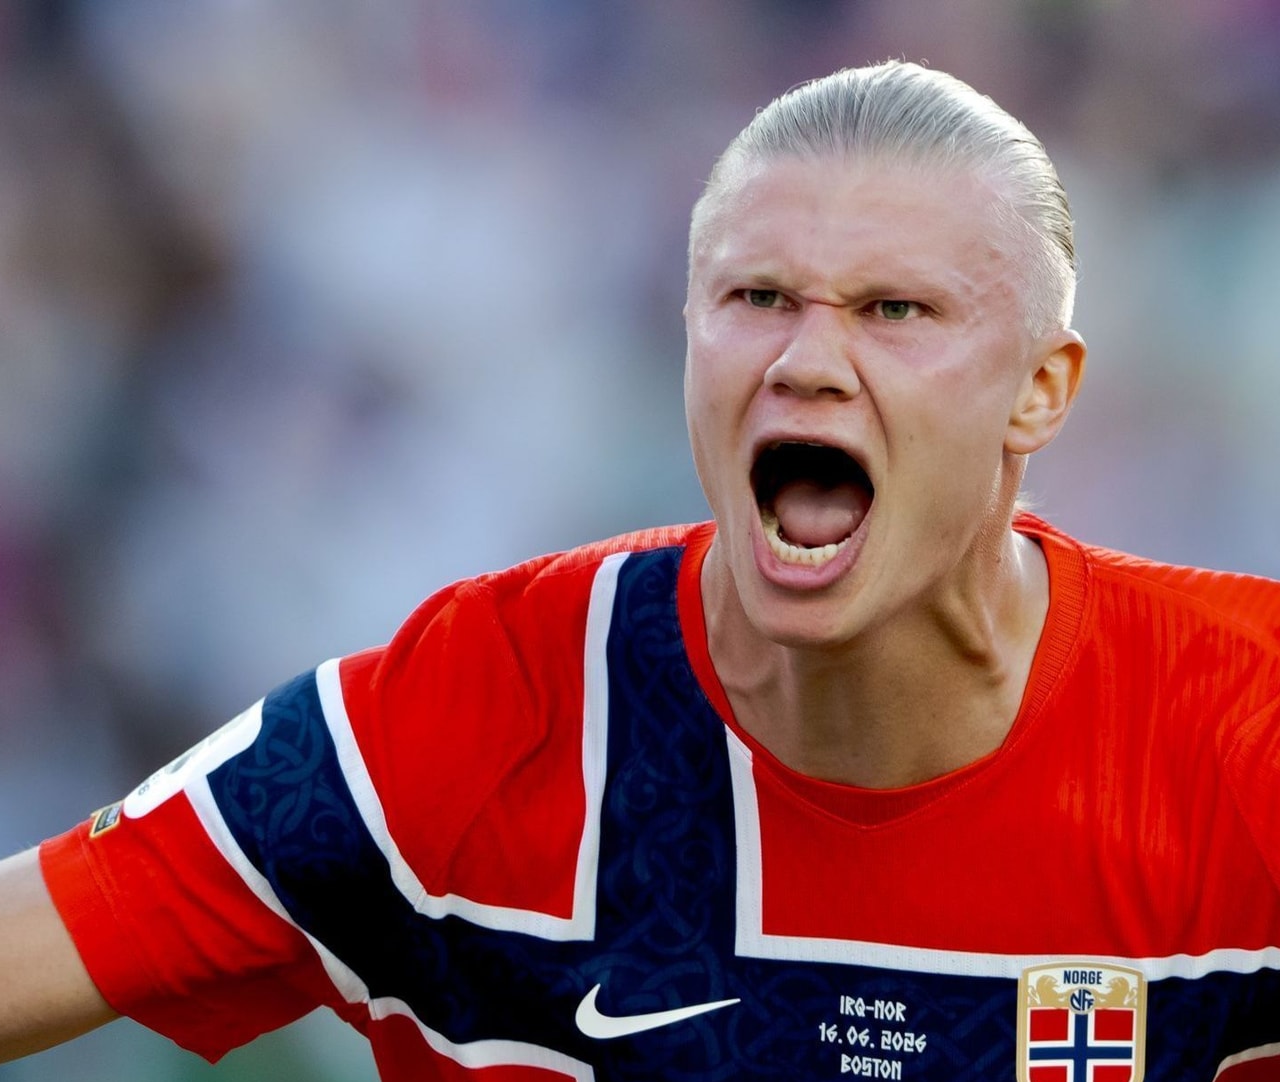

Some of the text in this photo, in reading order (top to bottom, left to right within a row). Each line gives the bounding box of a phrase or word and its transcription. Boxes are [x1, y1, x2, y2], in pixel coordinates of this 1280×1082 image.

[1063, 970, 1103, 985] NORGE
[839, 995, 907, 1022] IRQ-NOR
[840, 1053, 902, 1081] BOSTON
